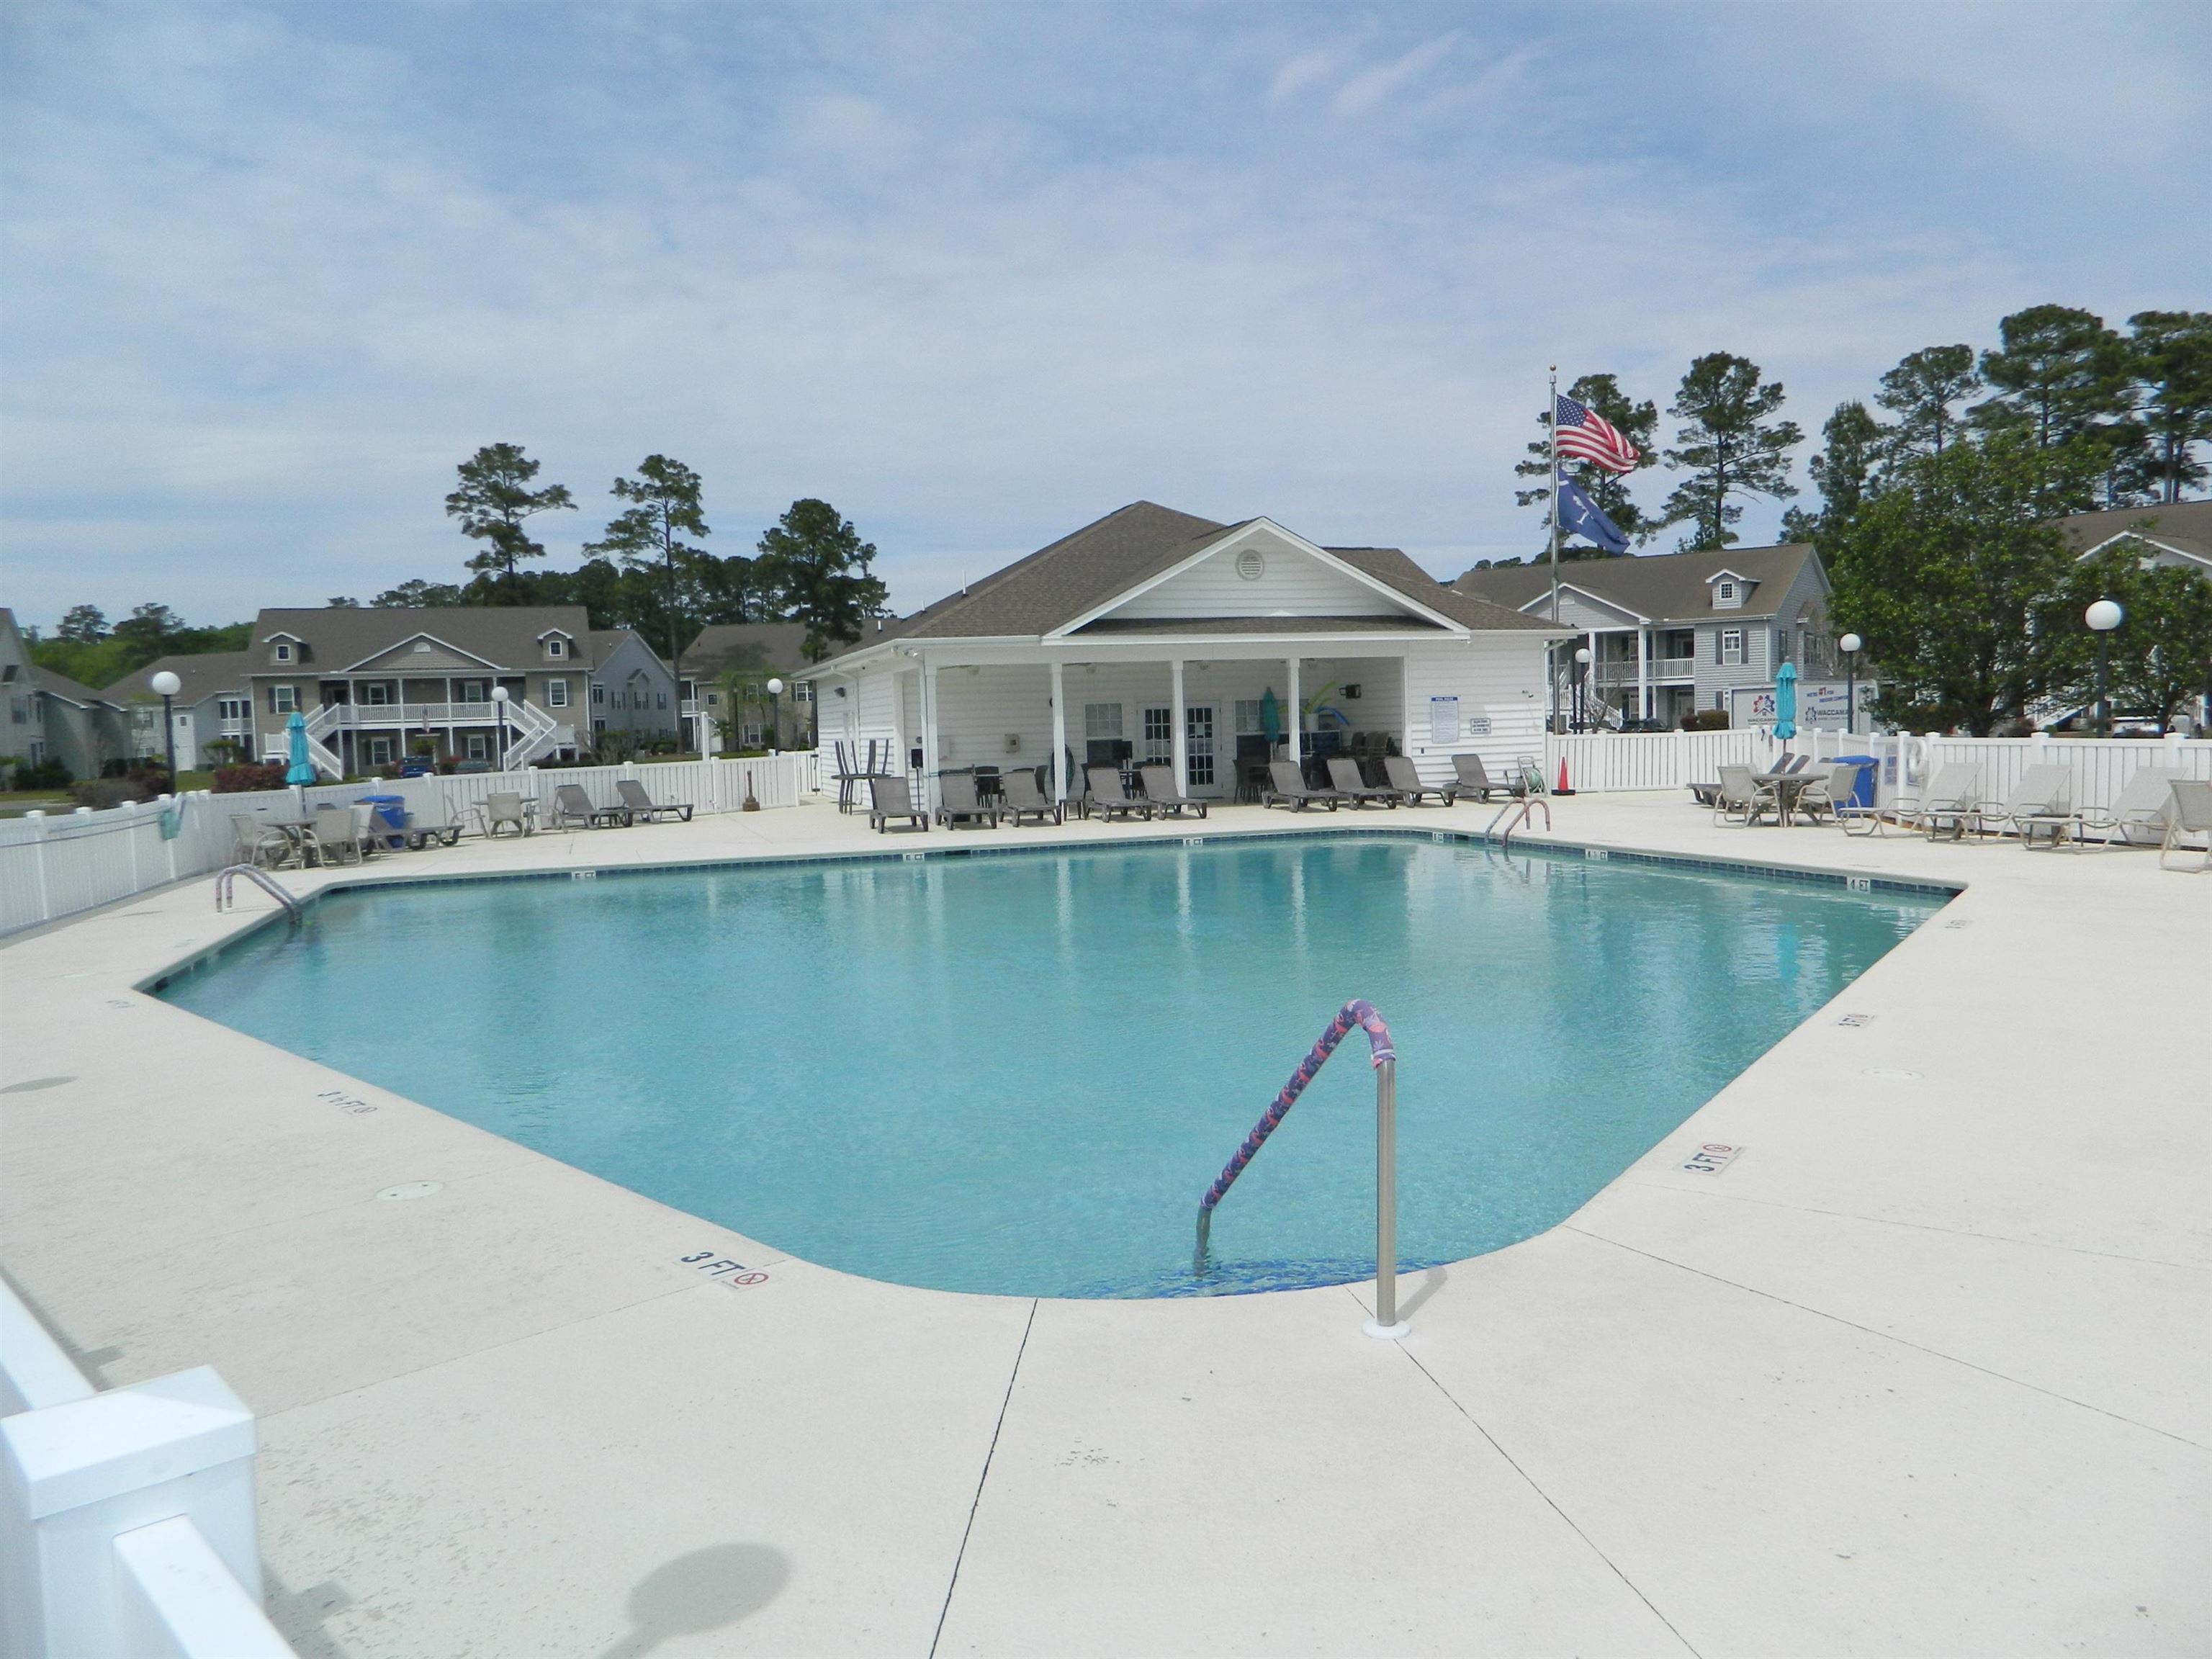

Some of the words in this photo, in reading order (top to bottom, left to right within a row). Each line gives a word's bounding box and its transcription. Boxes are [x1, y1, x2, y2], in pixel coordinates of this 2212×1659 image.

[1819, 687, 1826, 696] #1
[1691, 1152, 1728, 1164] FT
[680, 1251, 714, 1263] 3
[698, 1259, 746, 1276] FT
